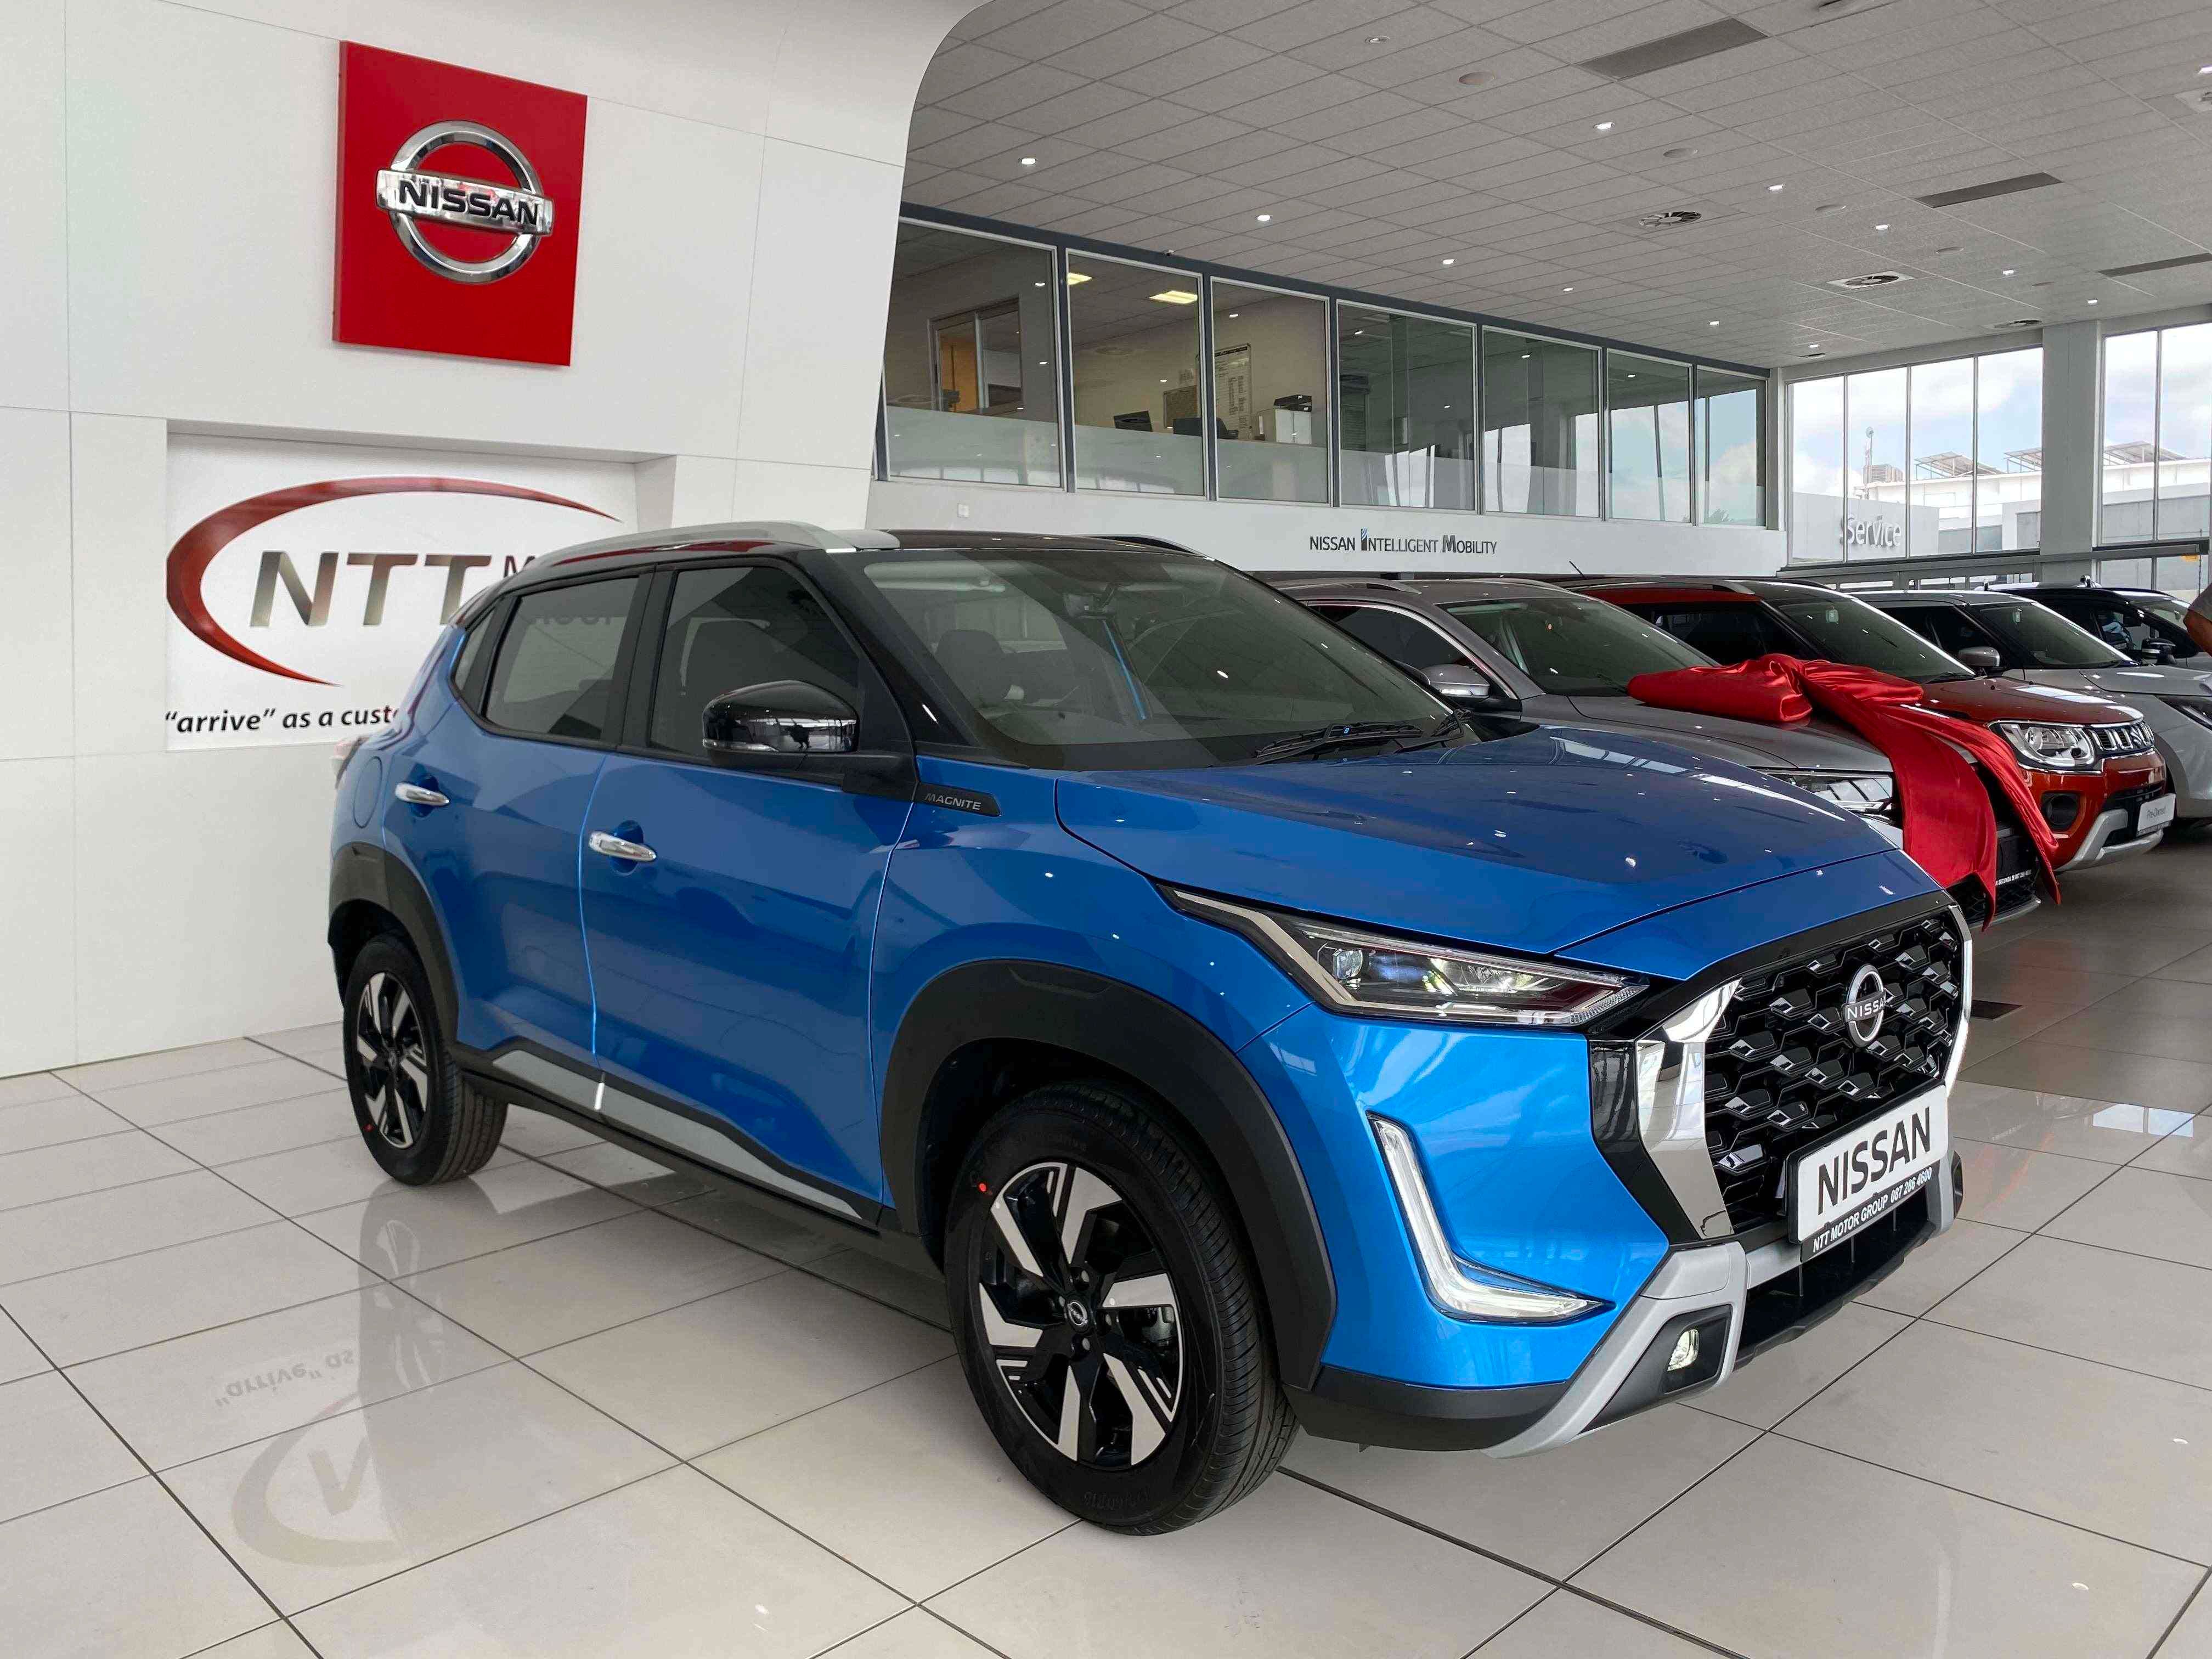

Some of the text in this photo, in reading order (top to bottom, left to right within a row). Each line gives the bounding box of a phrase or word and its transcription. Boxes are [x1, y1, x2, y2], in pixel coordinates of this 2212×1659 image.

[399, 179, 539, 225] NISSAN
[1310, 527, 1497, 554] NISSAN INTELLIGENT MOBILITY
[1839, 515, 1901, 547] Service
[249, 550, 493, 627] NTT
[283, 713, 311, 729] as
[318, 710, 333, 726] a
[926, 793, 981, 811] MAGNITE
[1818, 1107, 1930, 1216] NISSAN
[1813, 1231, 1830, 1252] NTT
[1830, 1212, 1859, 1242] MOTOR
[1860, 1194, 1888, 1222] GROUP
[1891, 1184, 1903, 1203] 087
[1903, 1176, 1916, 1195] 286
